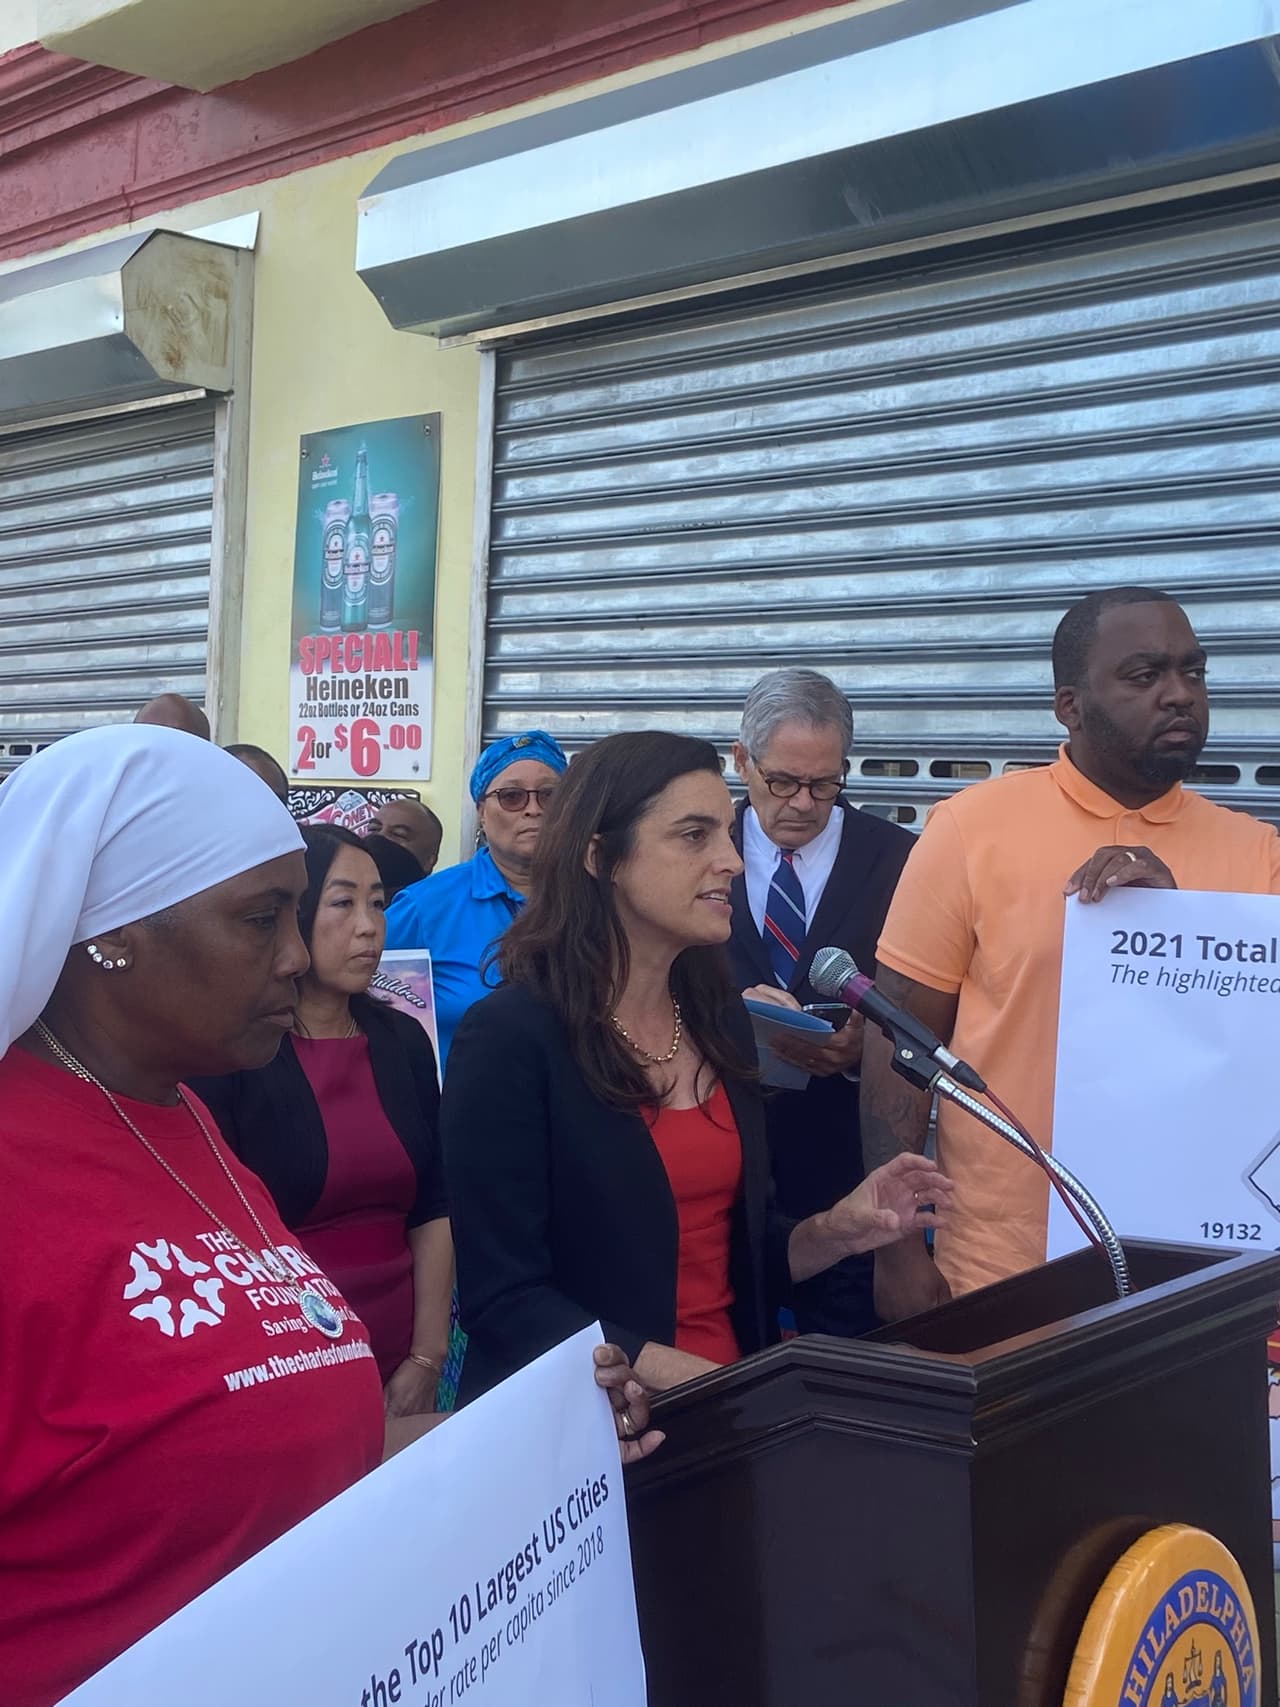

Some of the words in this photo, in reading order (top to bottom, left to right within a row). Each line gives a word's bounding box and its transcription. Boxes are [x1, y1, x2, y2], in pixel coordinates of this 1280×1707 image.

[300, 632, 418, 674] SPECIAL!
[306, 674, 409, 701] Heineken
[299, 703, 317, 718] 22oz
[318, 702, 349, 717] Bottles
[350, 703, 361, 717] or
[362, 701, 388, 717] 24oz
[390, 701, 420, 717] Cans
[297, 725, 317, 770] 2
[311, 740, 332, 759] for
[1111, 929, 1184, 959] 2021
[1196, 935, 1278, 964] Total
[1111, 963, 1149, 986] The
[196, 1231, 241, 1252] THE
[1200, 1222, 1262, 1241] 19132
[262, 1316, 308, 1336] Saving
[361, 1668, 401, 1707] the
[405, 1628, 443, 1684] Top
[449, 1594, 471, 1643] 10
[475, 1532, 541, 1621] Largest
[543, 1506, 565, 1553] US
[567, 1473, 609, 1530] Cities
[451, 1656, 477, 1704] rate
[481, 1629, 502, 1683] per
[506, 1592, 544, 1646] capita
[547, 1559, 576, 1606] since
[578, 1525, 604, 1577] 2018
